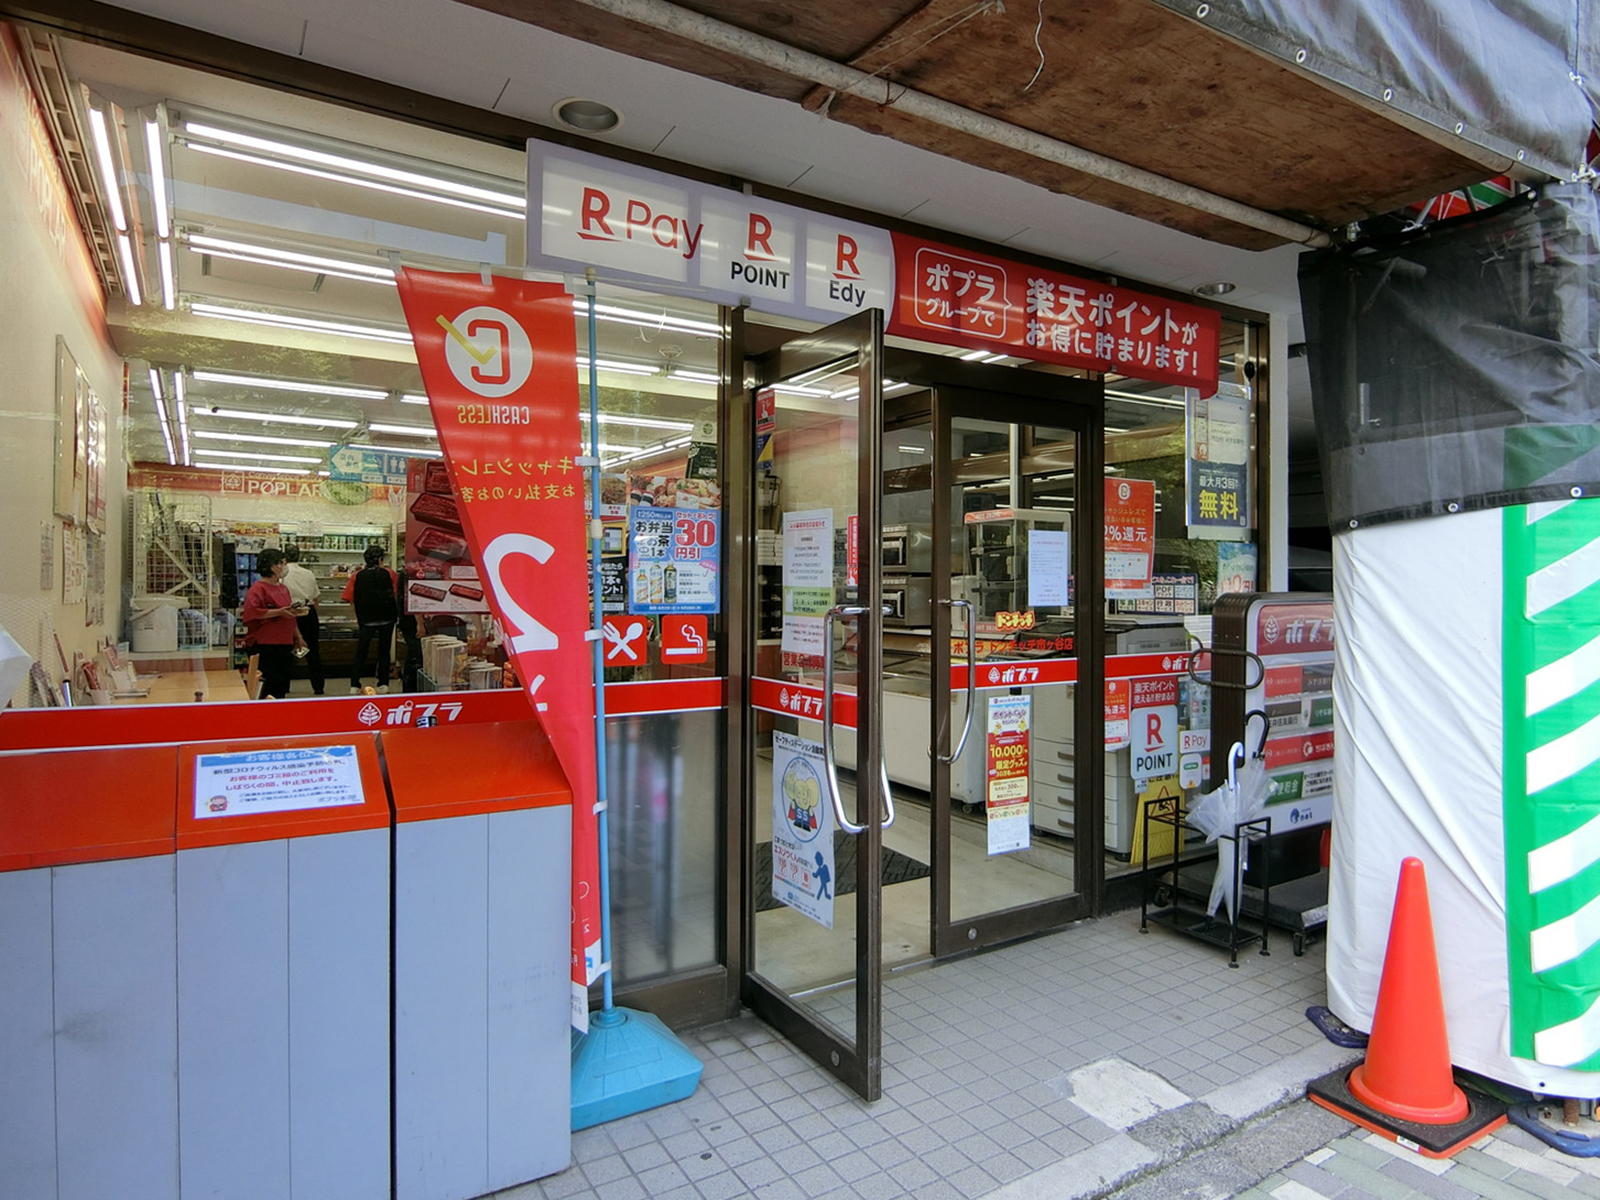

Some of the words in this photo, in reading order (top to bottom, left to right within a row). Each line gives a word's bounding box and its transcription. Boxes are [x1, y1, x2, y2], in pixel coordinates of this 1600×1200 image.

[626, 200, 703, 260] Pay
[730, 261, 790, 290] POINT
[926, 263, 996, 302] ポプラ
[829, 280, 866, 308] Edy
[925, 297, 996, 328] グループで
[1026, 277, 1199, 346] 楽天ポイントが
[1026, 319, 1199, 376] お得に貯まります!
[1198, 489, 1239, 521] 無料
[635, 520, 673, 534] お弁当
[675, 519, 716, 547] 30
[1001, 665, 1039, 683] ポプラ
[1133, 680, 1175, 693] 楽天ポイント
[386, 700, 464, 726] ポプラ
[789, 690, 824, 716] ポプラ
[1191, 735, 1208, 748] Pay
[1136, 752, 1173, 772] POINT
[796, 809, 808, 822] SS
